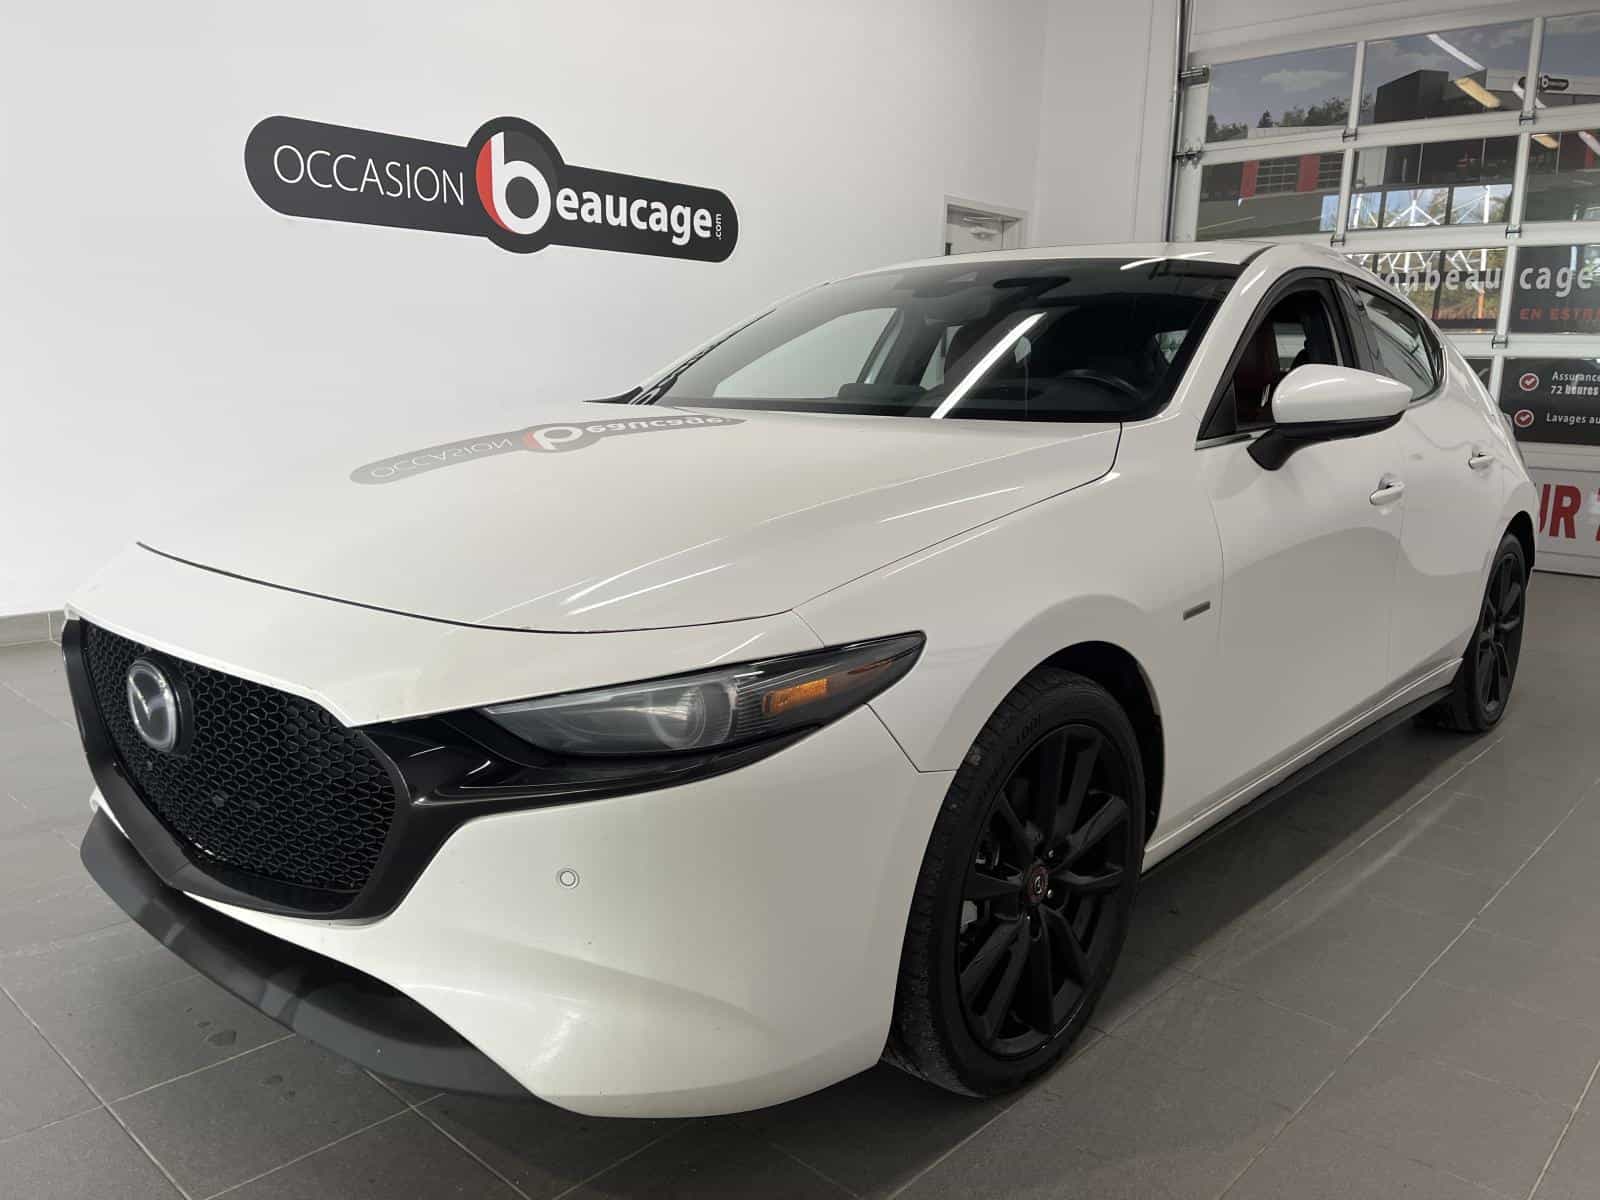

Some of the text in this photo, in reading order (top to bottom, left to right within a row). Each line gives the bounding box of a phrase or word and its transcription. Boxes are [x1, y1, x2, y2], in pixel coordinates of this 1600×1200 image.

[273, 145, 465, 206] OCCASION
[490, 131, 713, 246] beaucage
[1551, 384, 1599, 396] 72 heures
[1546, 412, 1586, 426] Lavages
